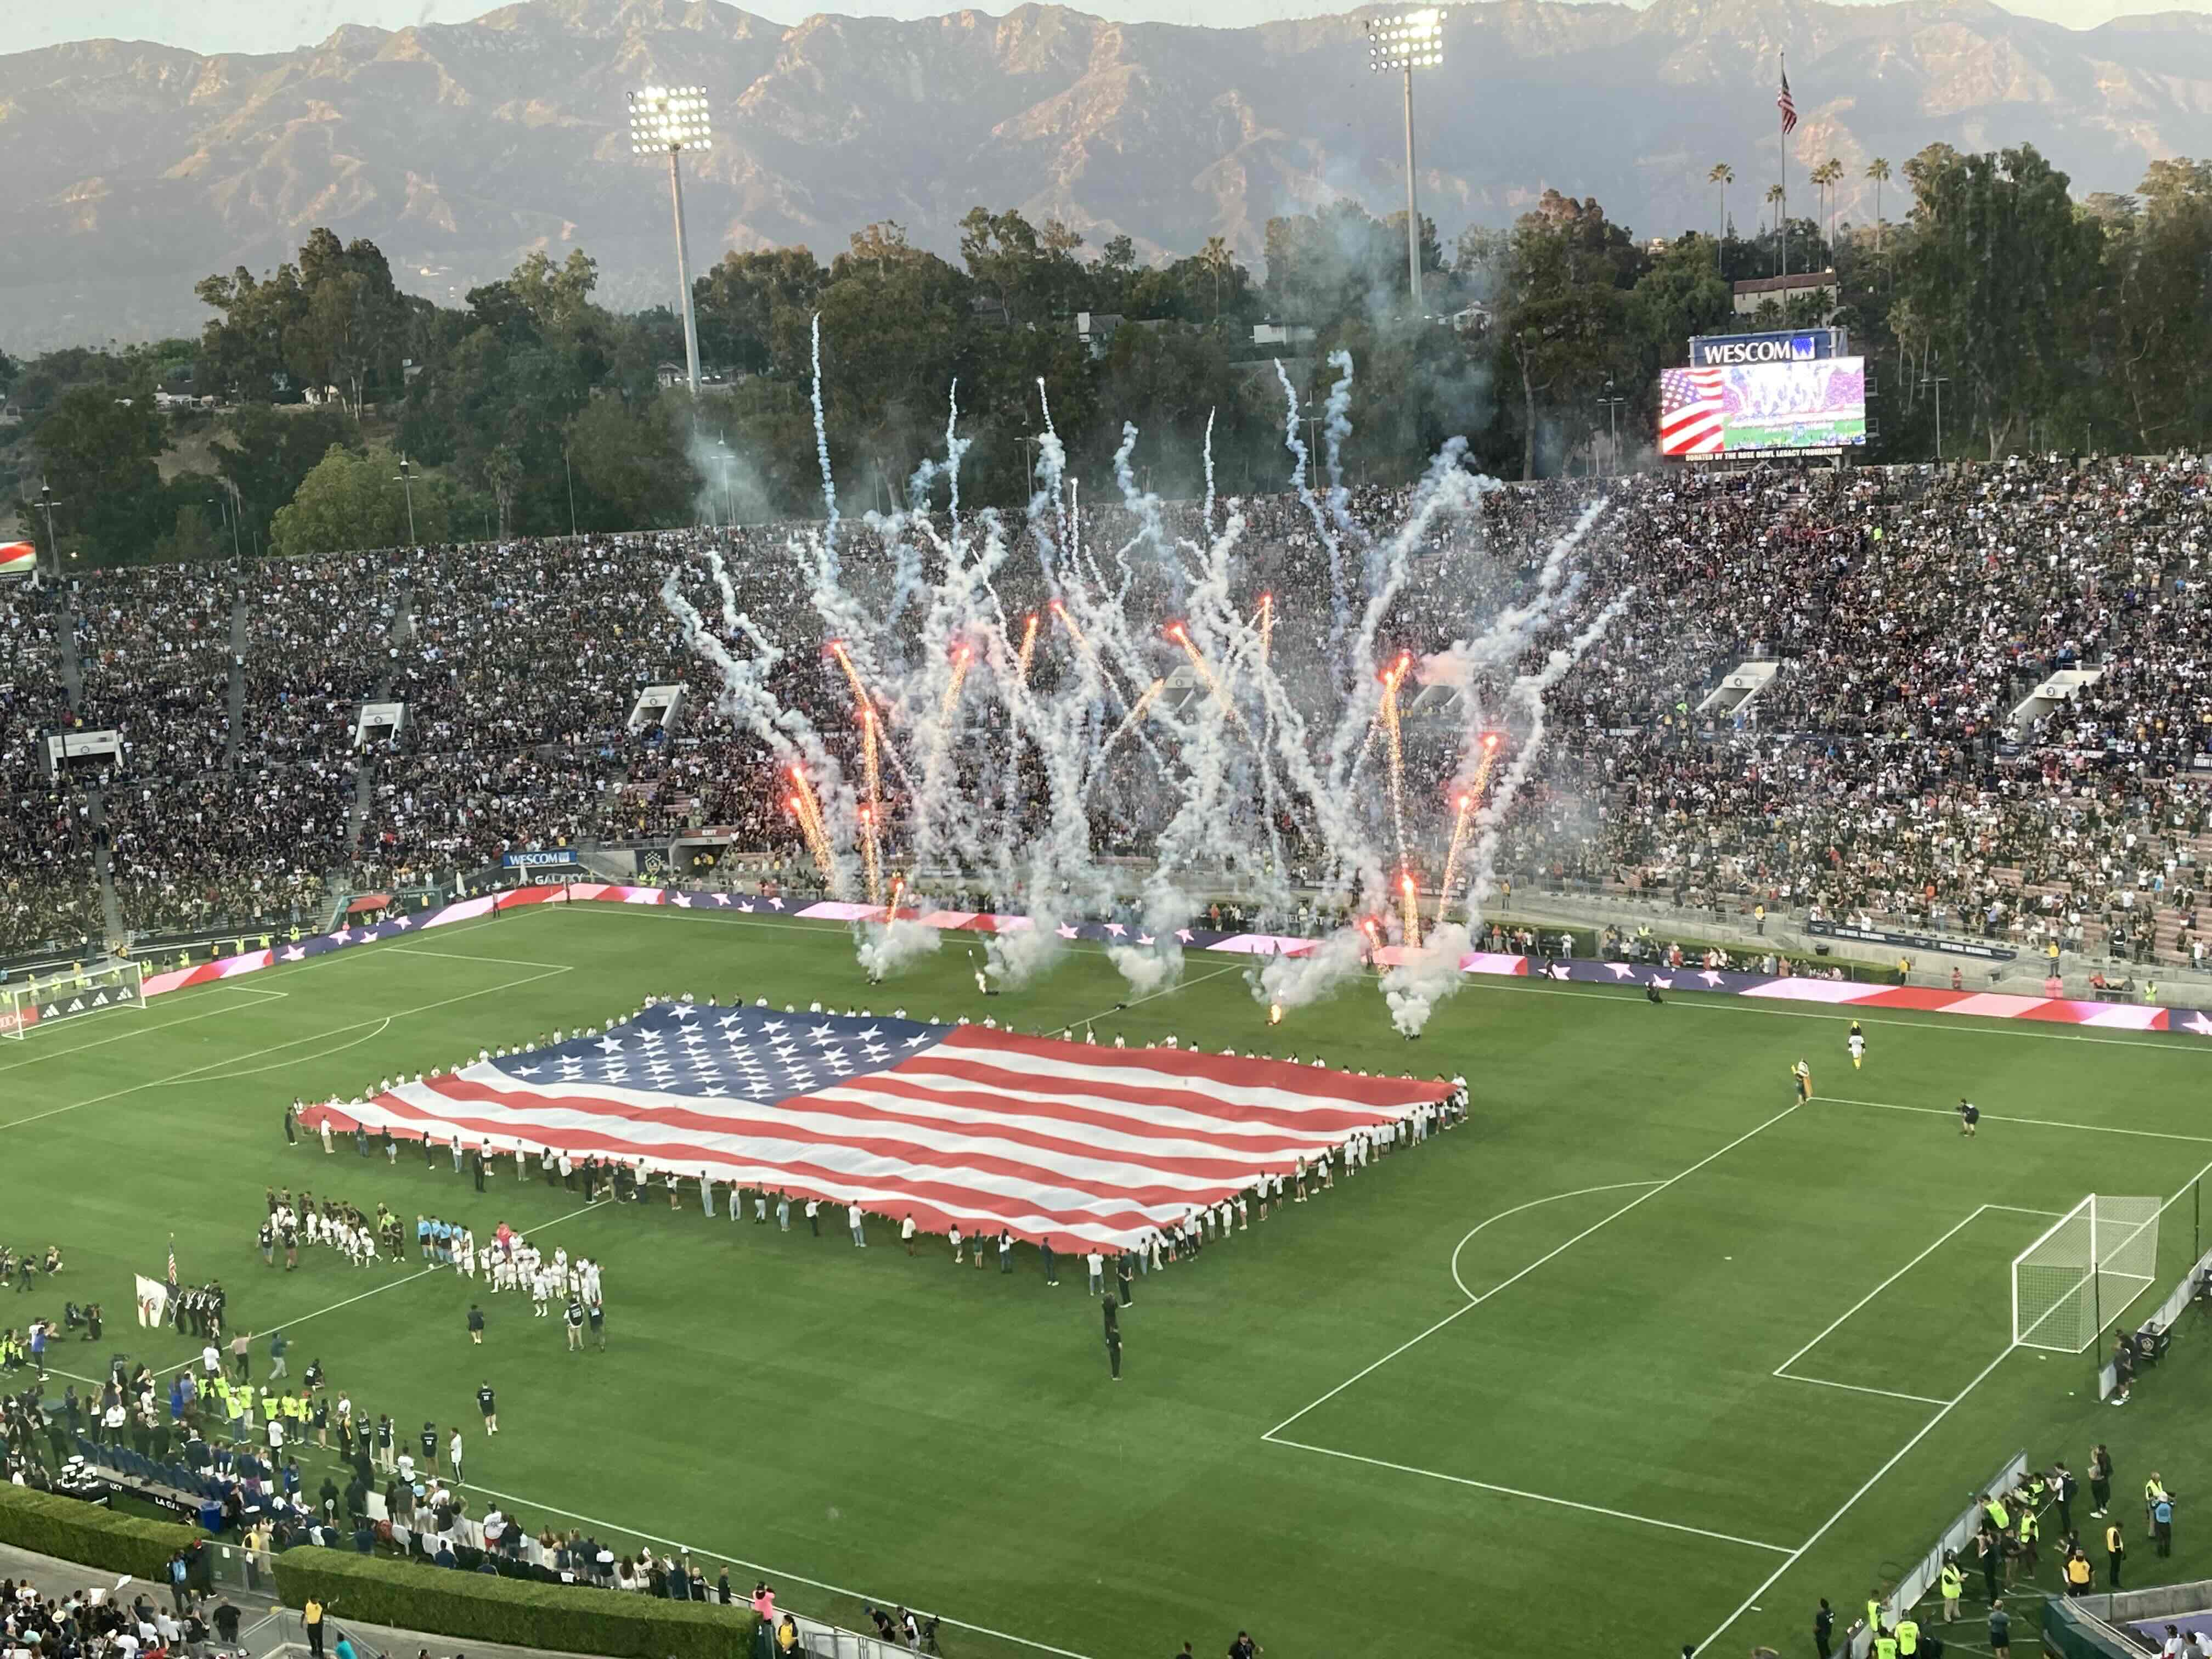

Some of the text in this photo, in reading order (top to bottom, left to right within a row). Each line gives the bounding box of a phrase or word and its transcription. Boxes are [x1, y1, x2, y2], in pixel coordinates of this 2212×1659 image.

[1704, 340, 1791, 364] WESCOM
[1685, 453, 1713, 461] DONATED
[1776, 449, 1801, 458] LEGACY
[1802, 447, 1842, 456] FOUNDATION
[509, 853, 557, 865] WESCOM
[534, 873, 584, 885] GALAXY
